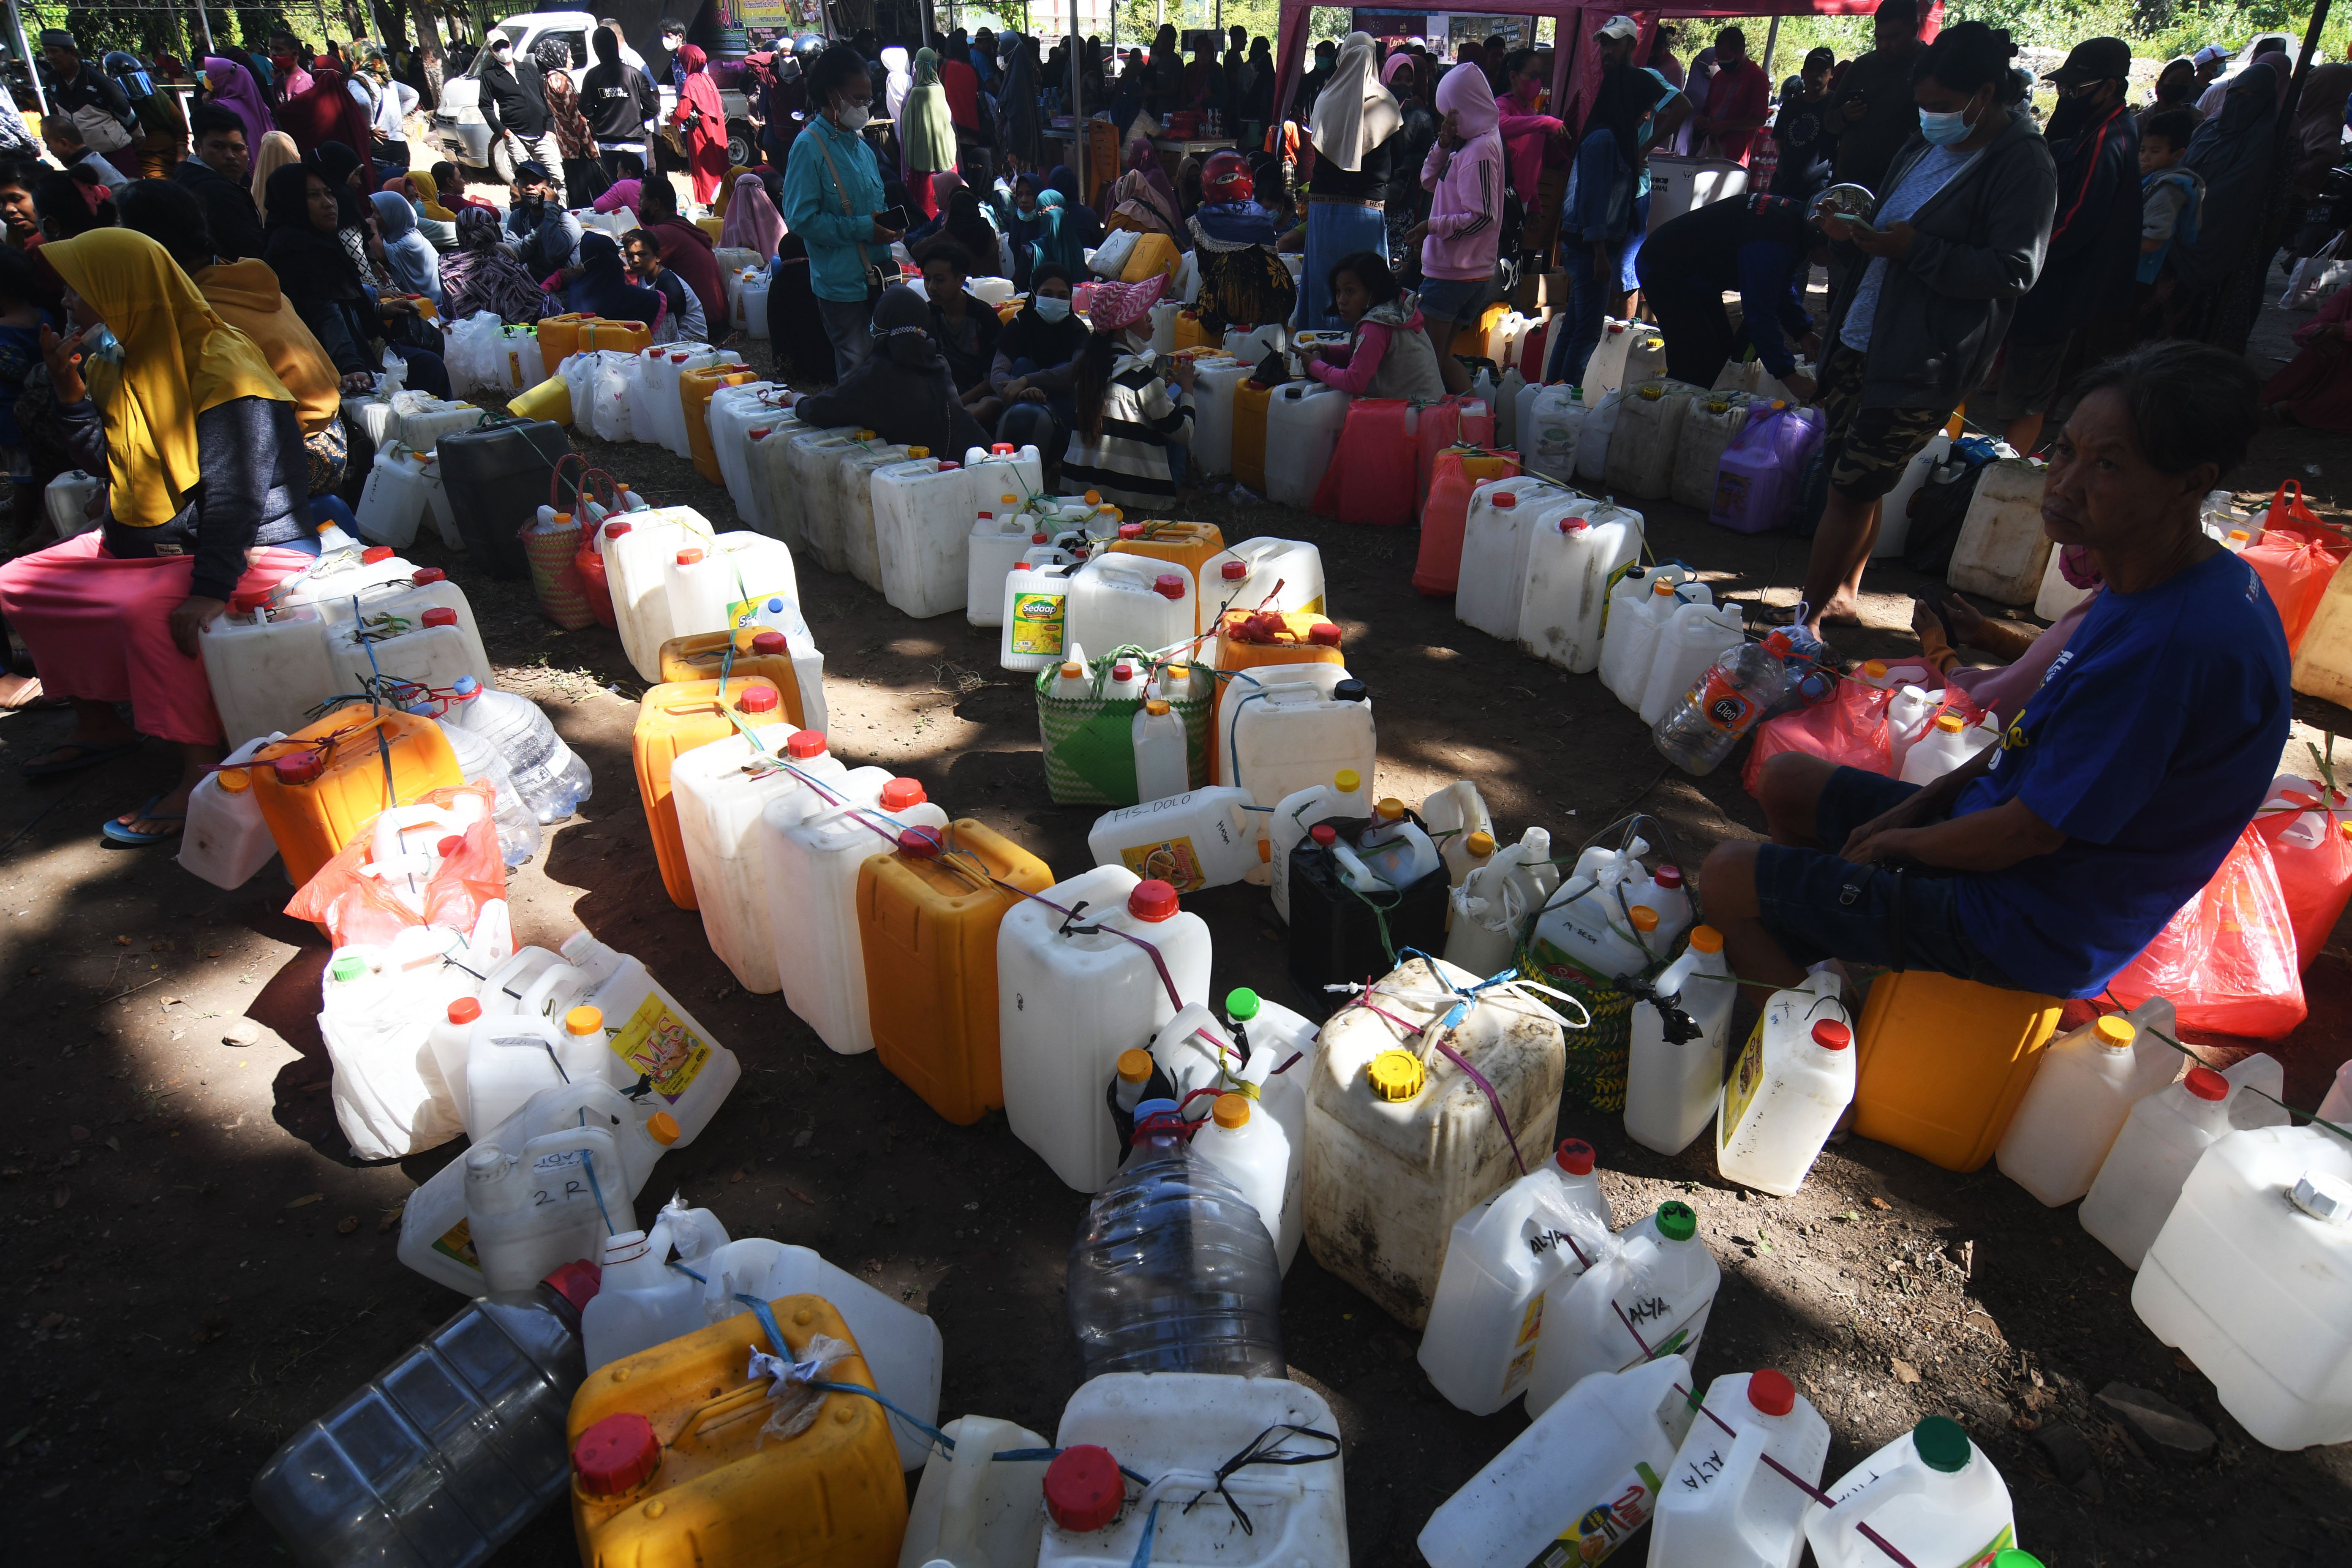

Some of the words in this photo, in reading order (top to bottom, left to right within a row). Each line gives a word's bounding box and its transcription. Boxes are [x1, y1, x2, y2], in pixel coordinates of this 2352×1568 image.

[1506, 33, 1520, 42] KAMU
[1802, 113, 1820, 141] CONVERSE
[1329, 196, 1366, 205] HERMES
[1106, 239, 1119, 251] A
[1135, 245, 1146, 259] A
[1023, 604, 1056, 615] Sedaap
[1716, 702, 1736, 721] Cleo
[631, 1036, 668, 1076] M
[695, 1048, 706, 1062] 4500
[534, 1190, 556, 1206] 2
[566, 1181, 588, 1200] R
[1530, 1230, 1567, 1257] ALYA
[1629, 1297, 1670, 1328] ALYA
[1682, 1450, 1724, 1489] ALYA
